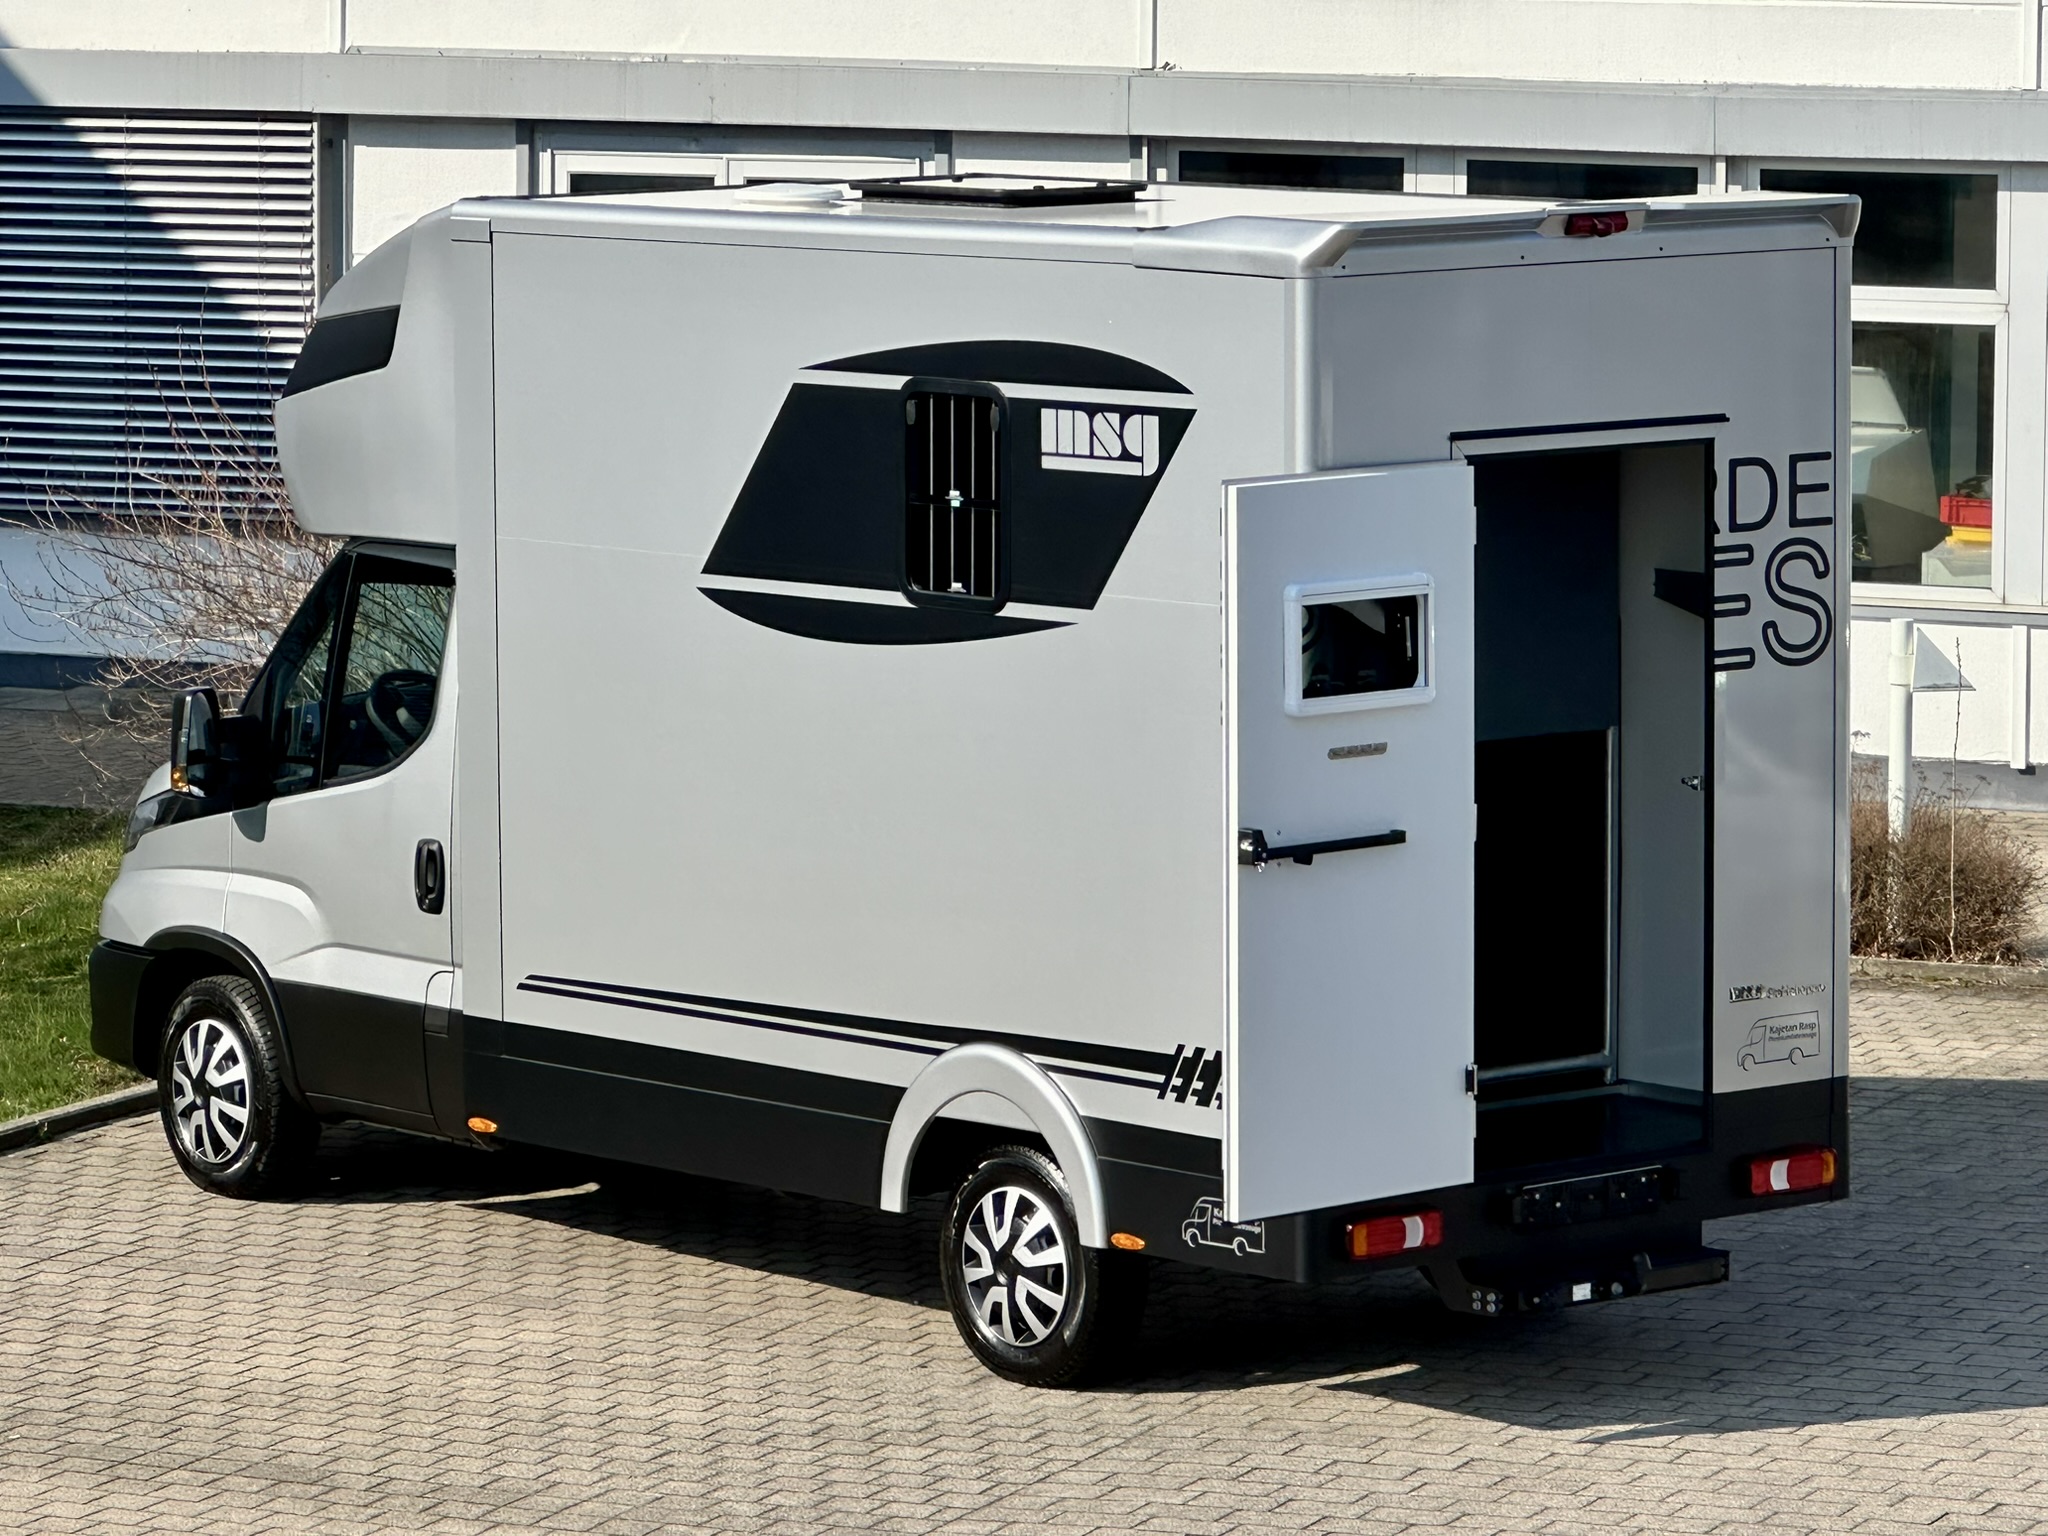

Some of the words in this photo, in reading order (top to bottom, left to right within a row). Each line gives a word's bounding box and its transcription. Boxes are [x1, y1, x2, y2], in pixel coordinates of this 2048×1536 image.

[1714, 451, 1833, 534] DE
[1769, 1024, 1798, 1036] Kajetan
[1799, 1021, 1817, 1031] Rasp
